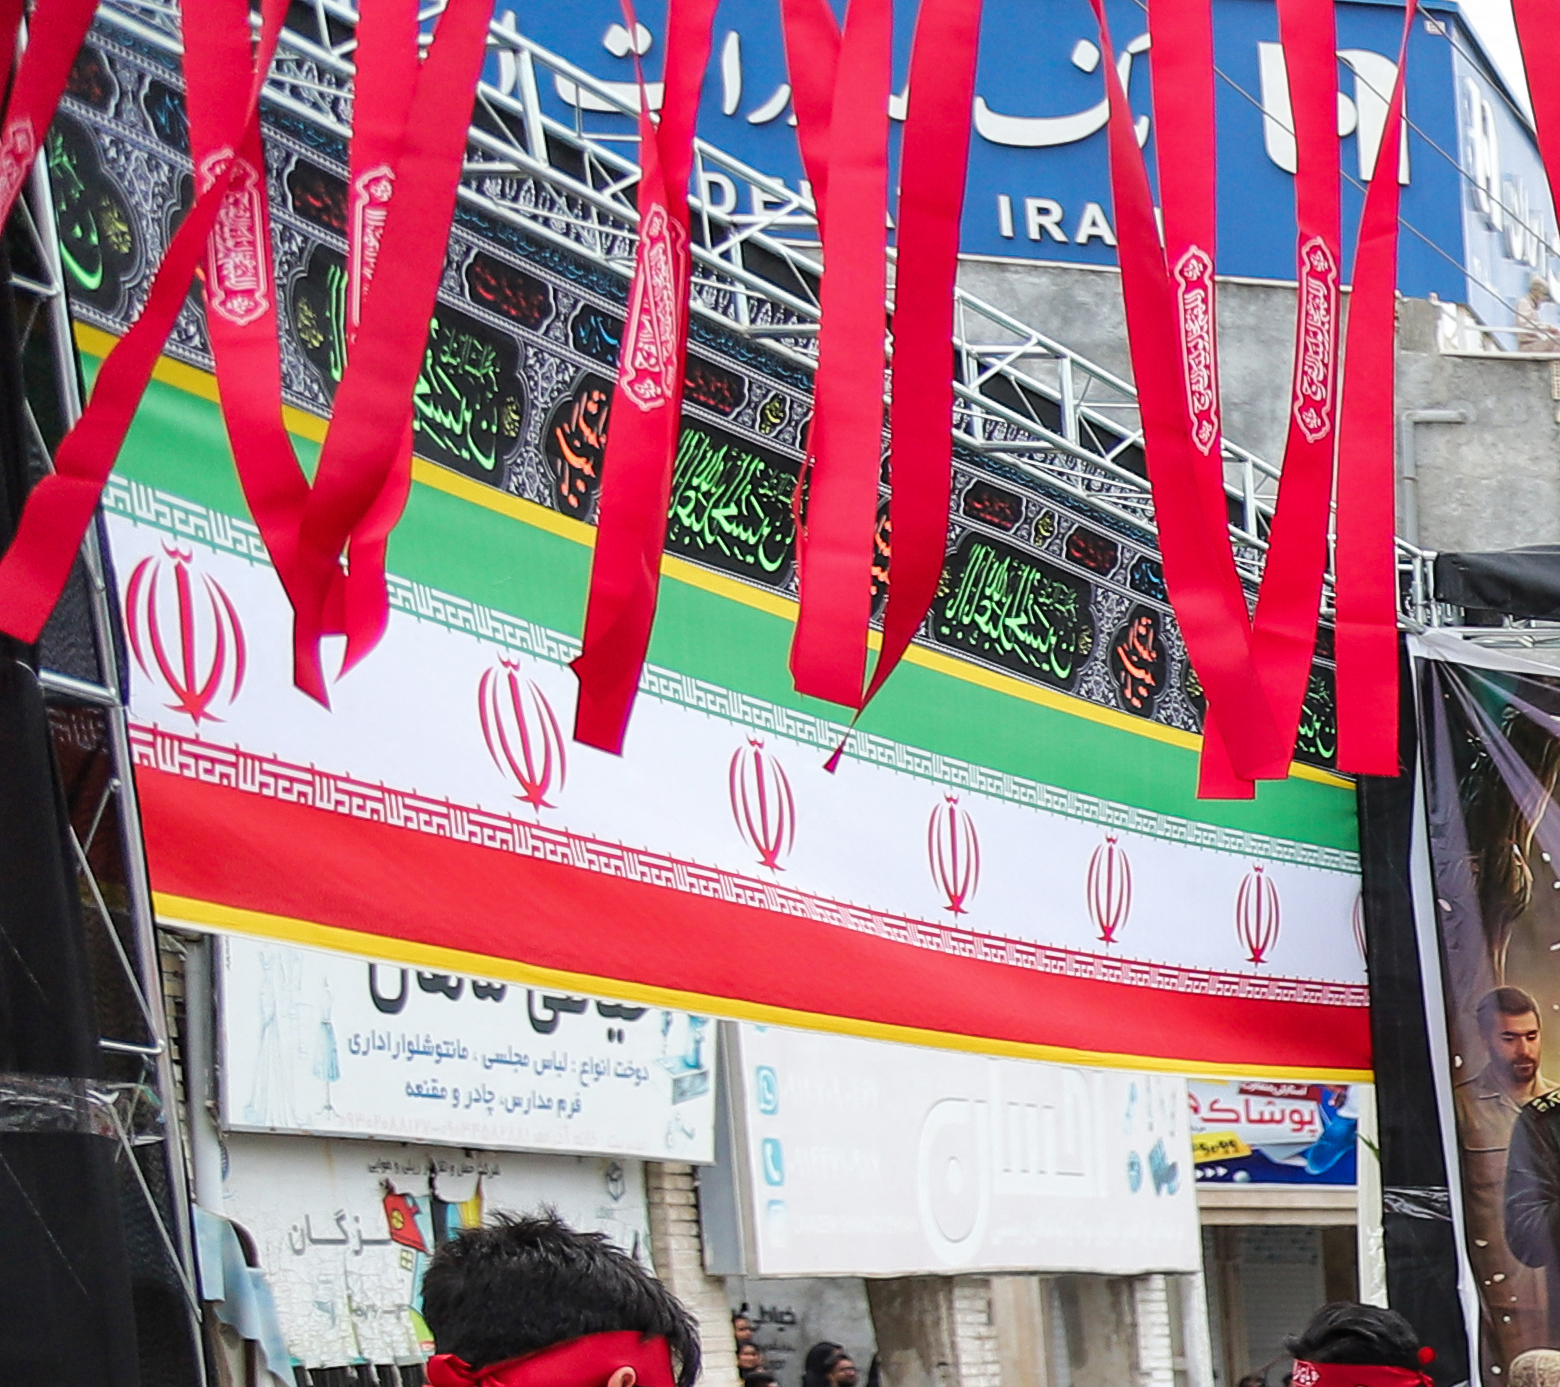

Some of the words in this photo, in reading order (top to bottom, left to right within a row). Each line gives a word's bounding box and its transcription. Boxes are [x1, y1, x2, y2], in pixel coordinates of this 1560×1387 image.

[998, 194, 1164, 248] IRA
[347, 1029, 392, 1055] اداری
[483, 1043, 531, 1070] مجلسی
[534, 1050, 569, 1077] لباس
[579, 1056, 611, 1087] انواع
[612, 1061, 650, 1087] دوخت
[405, 1077, 447, 1100] مقنعه
[452, 1087, 461, 1109] و
[464, 1083, 495, 1116] چادر
[556, 1092, 582, 1120] فرم
[1201, 1099, 1319, 1138] پوشاک
[287, 1208, 392, 1257] زگان
